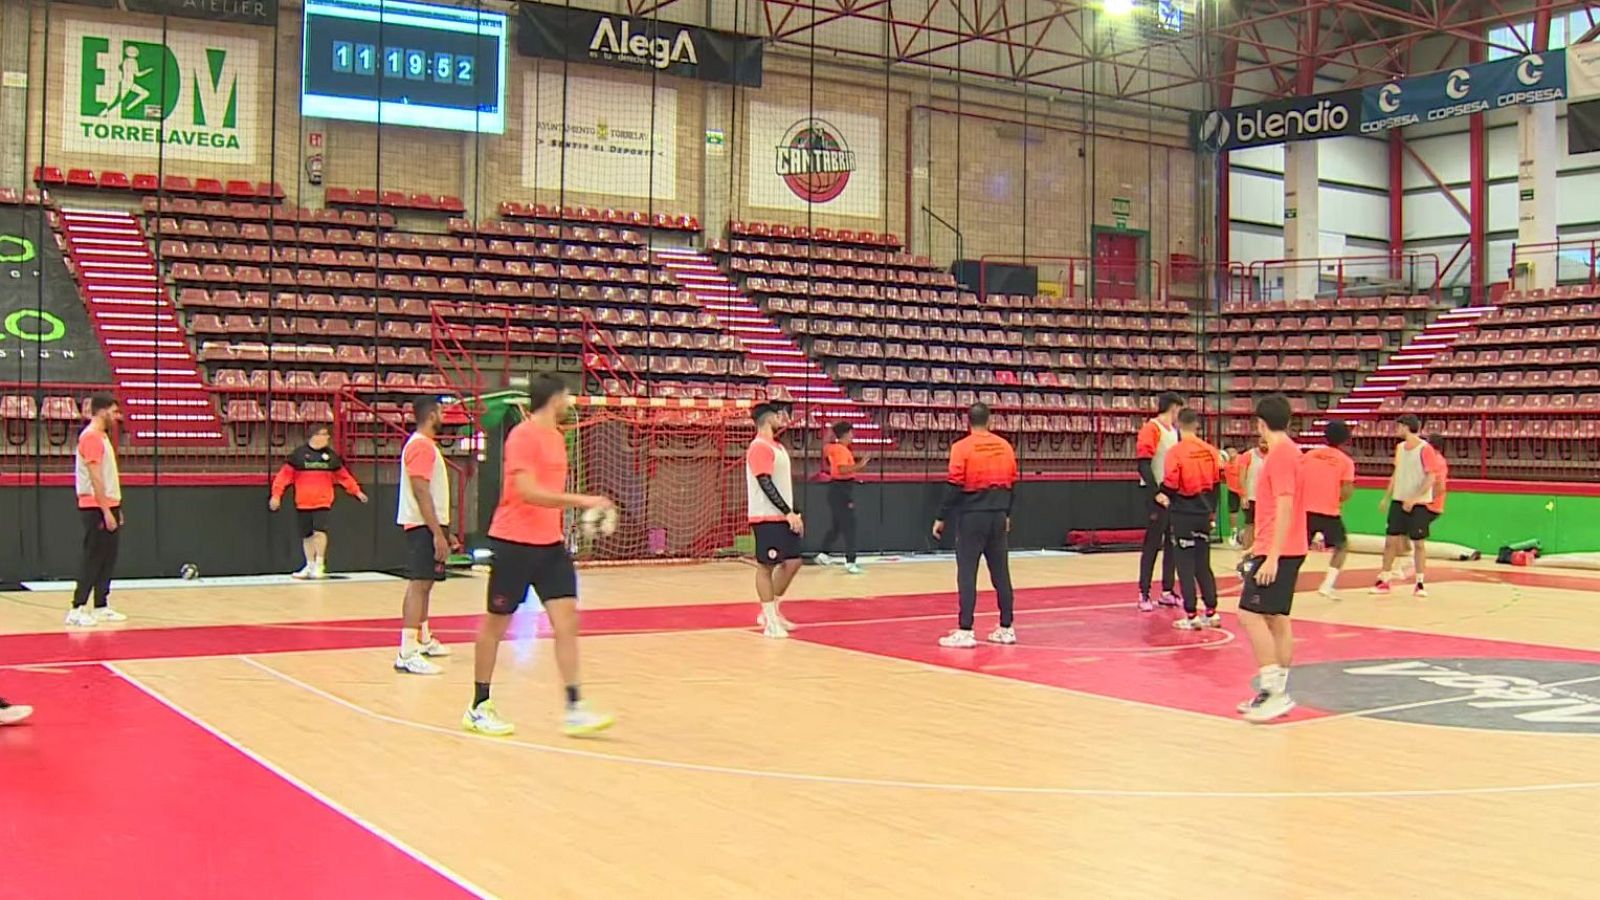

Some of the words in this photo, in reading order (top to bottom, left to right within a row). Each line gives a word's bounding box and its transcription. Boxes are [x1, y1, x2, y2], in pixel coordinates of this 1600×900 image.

[589, 17, 698, 69] AlegA
[1428, 100, 1491, 121] COPSESA
[1498, 88, 1565, 107] COPSESA
[1237, 99, 1349, 142] blendio
[1360, 114, 1420, 133] COPSESA
[81, 122, 240, 149] TORRELAVEGA
[777, 147, 856, 174] CANTABRIA
